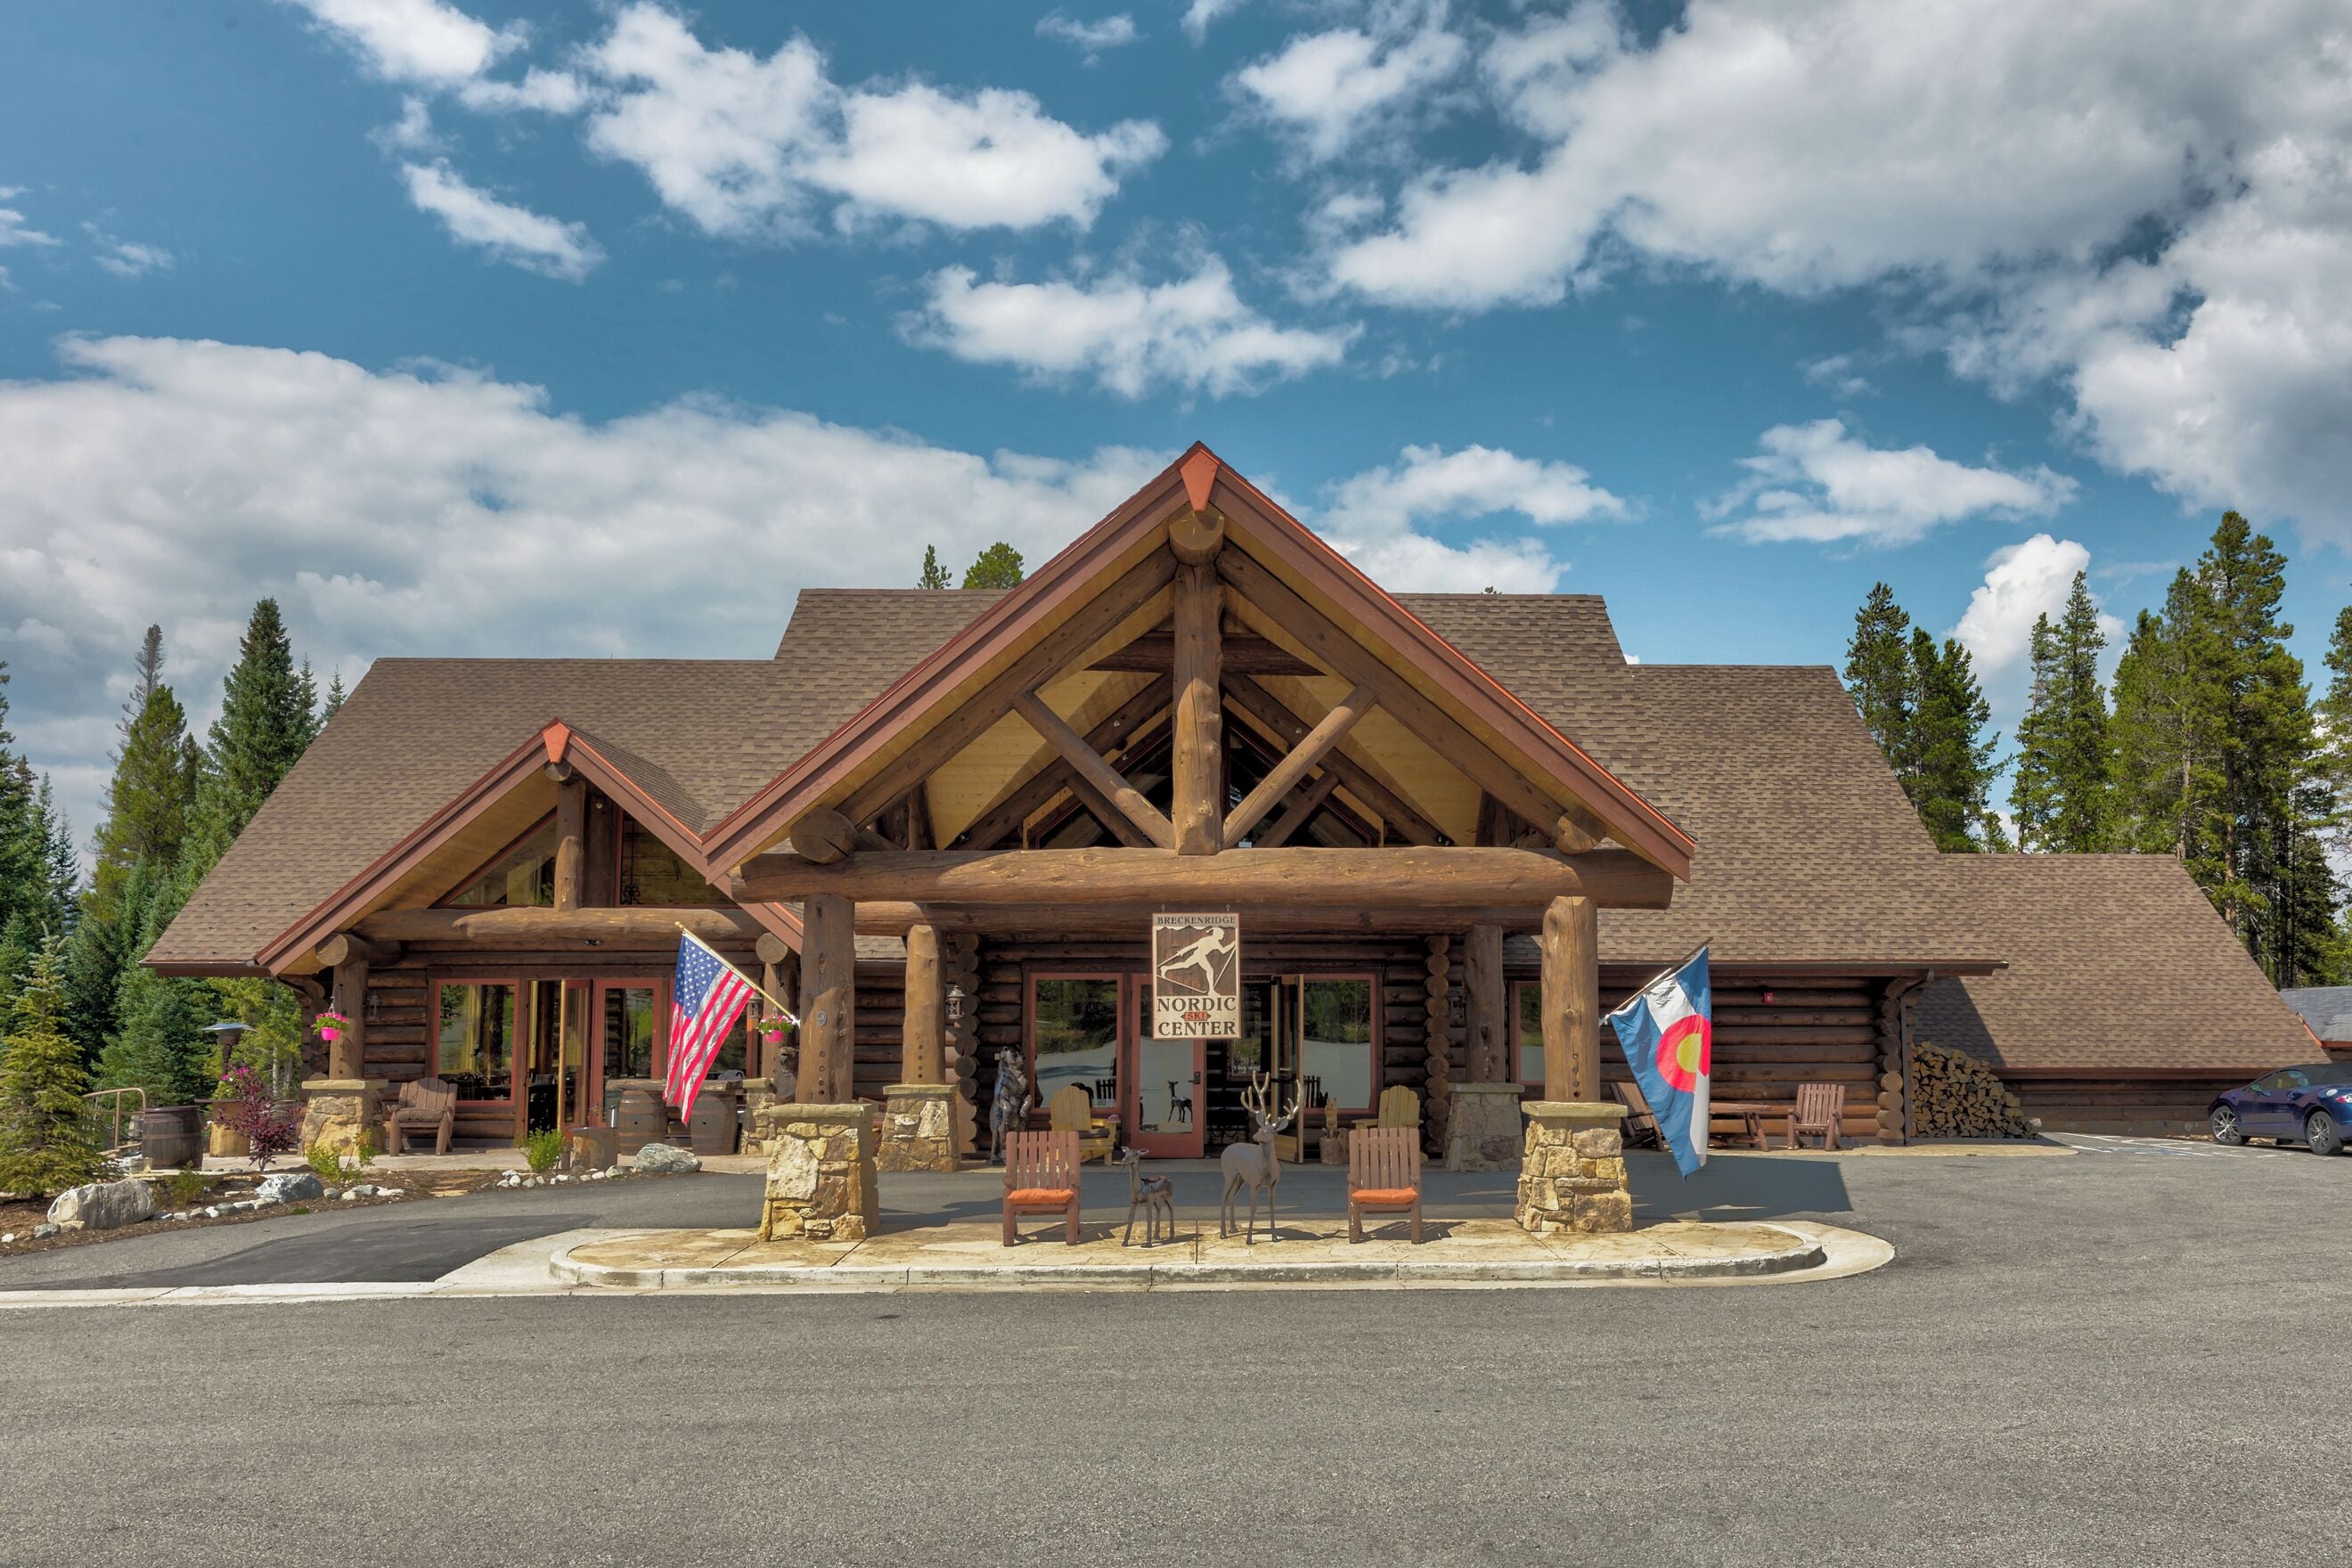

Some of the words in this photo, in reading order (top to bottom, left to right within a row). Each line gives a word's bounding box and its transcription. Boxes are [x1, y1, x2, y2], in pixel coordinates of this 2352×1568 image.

[1157, 917, 1236, 925] BRECKENRIDGE
[1157, 998, 1237, 1012] NORDIC
[1187, 1012, 1207, 1020] SKI
[1158, 1022, 1237, 1036] CENTER
